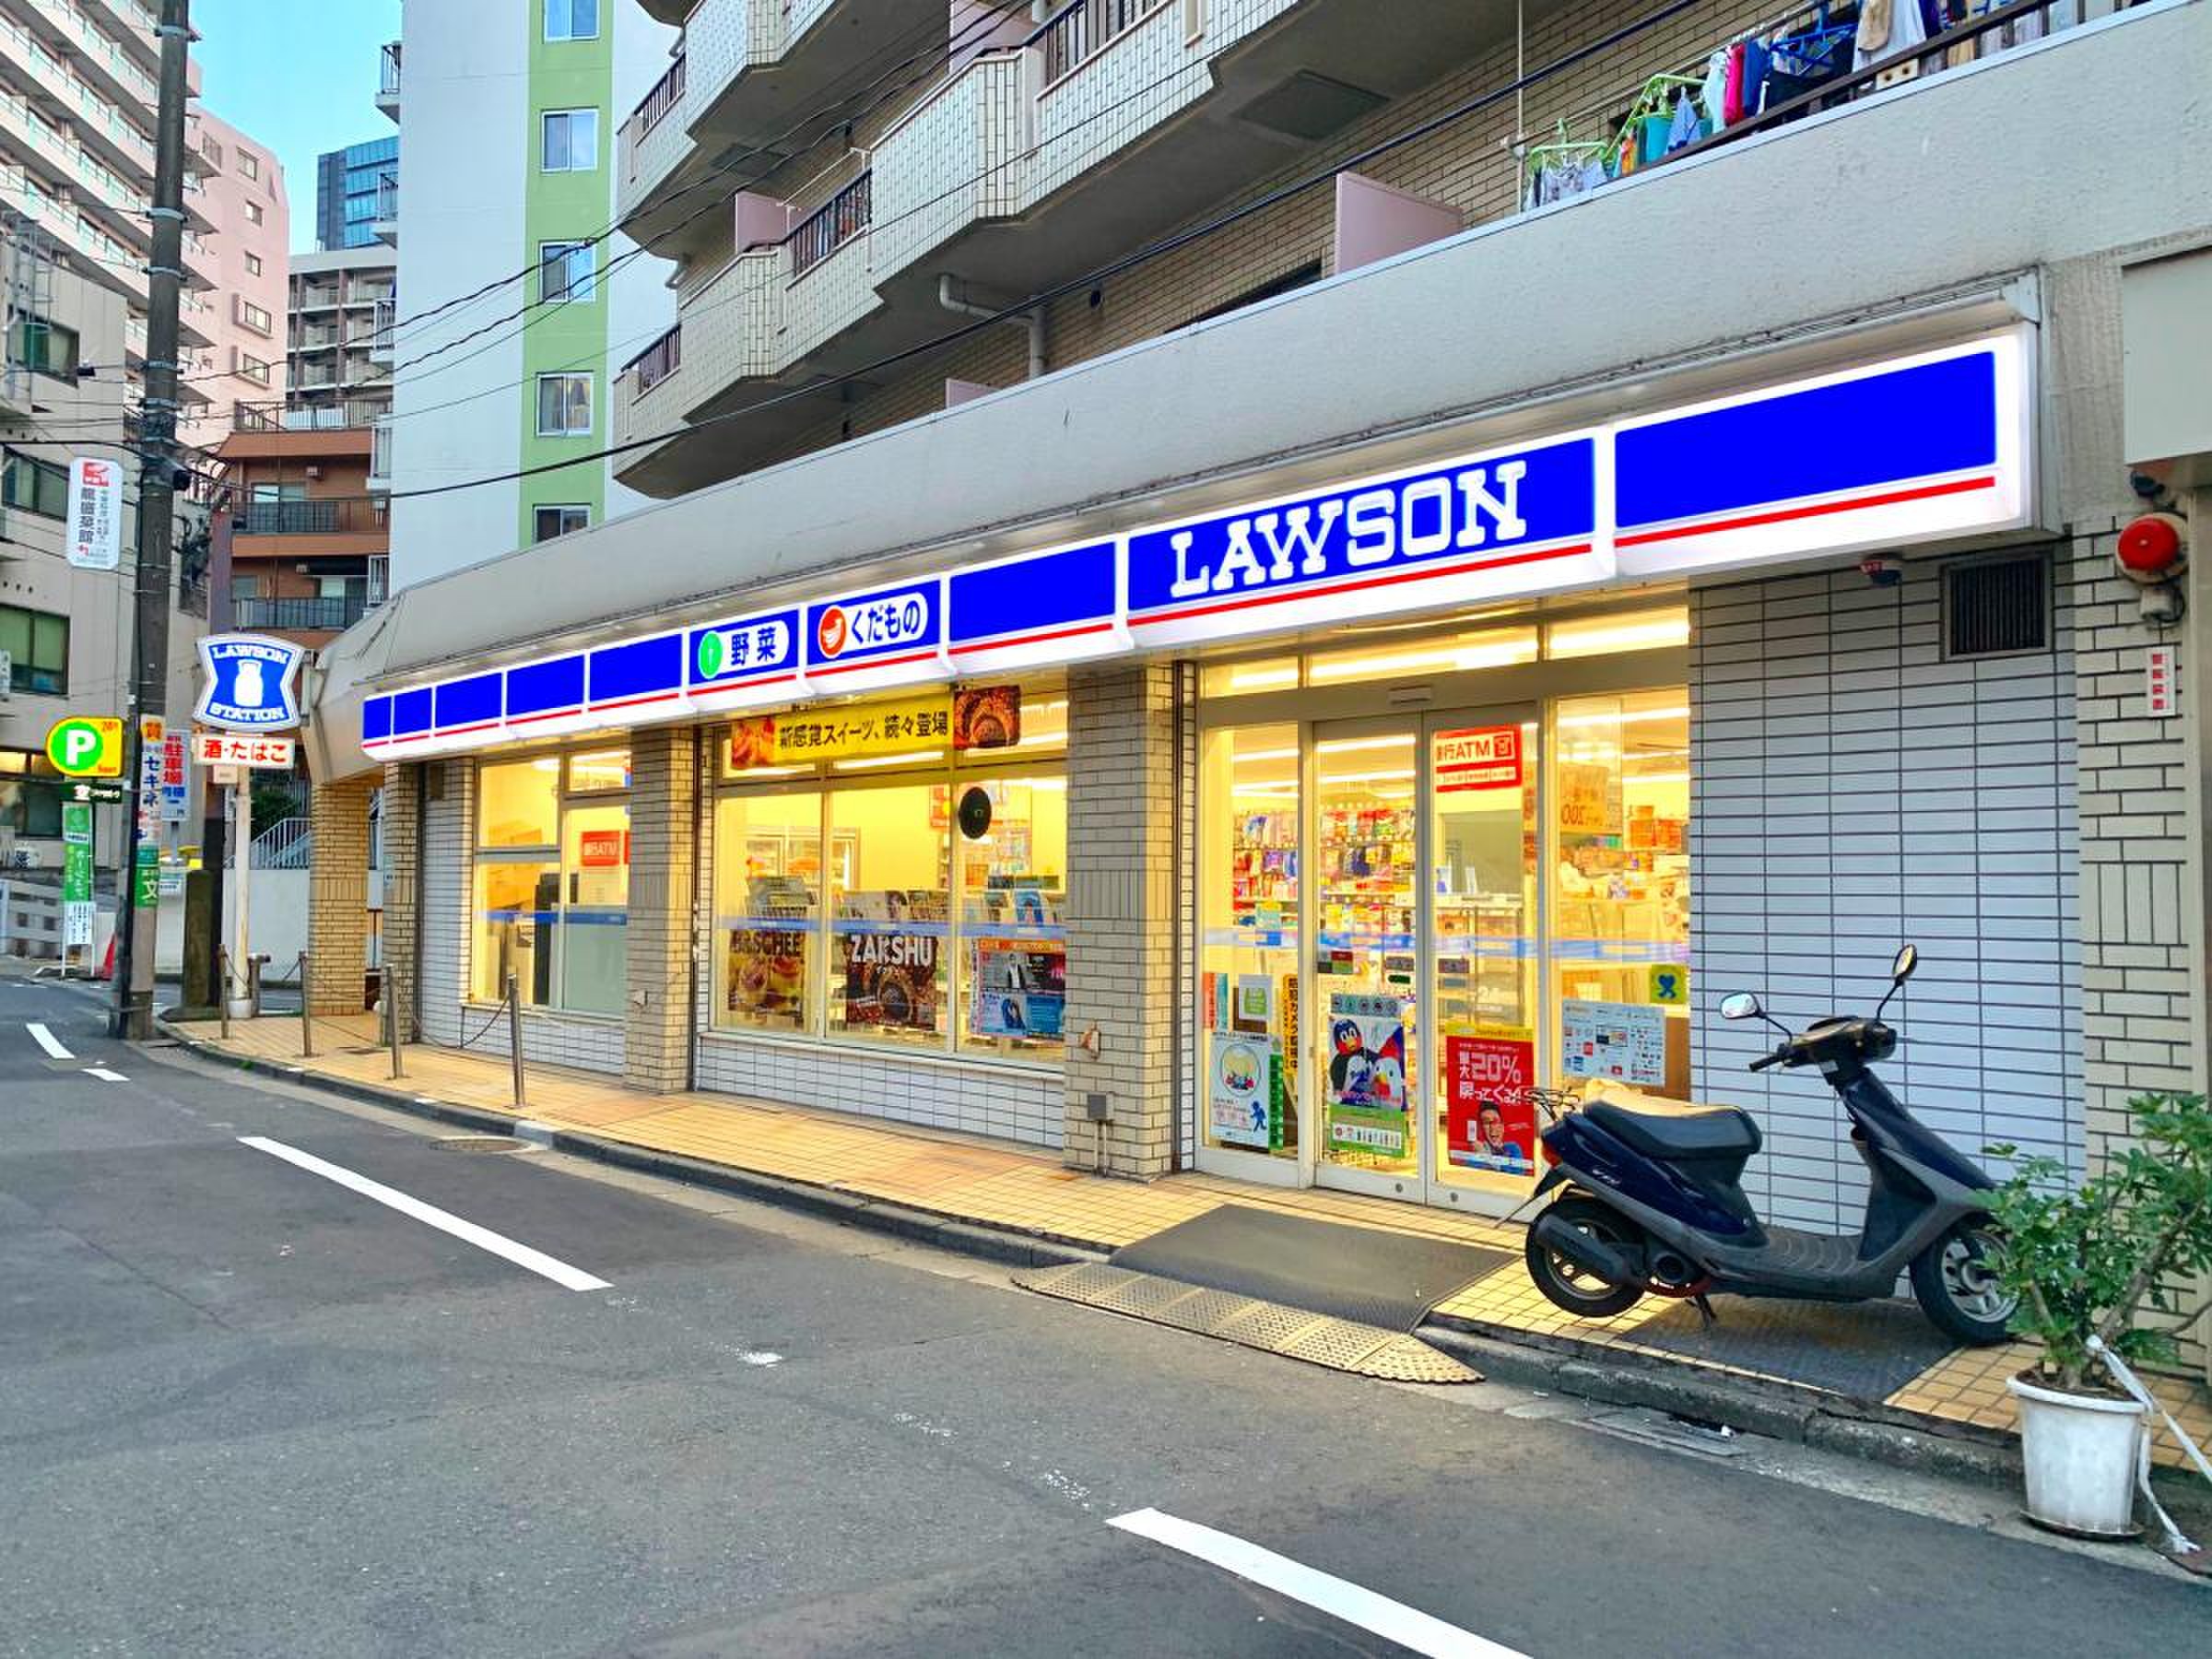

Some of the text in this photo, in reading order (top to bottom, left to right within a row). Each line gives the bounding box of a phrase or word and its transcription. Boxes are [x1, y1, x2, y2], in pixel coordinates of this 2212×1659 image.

[1171, 460, 1527, 597] LAWSON
[852, 600, 921, 643] くだもの
[211, 644, 289, 664] LAWSON
[731, 626, 776, 665] 野菜
[209, 701, 286, 721] STATION
[66, 729, 97, 766] P
[143, 756, 161, 807] セキネ
[851, 934, 933, 968] ZAKSHU
